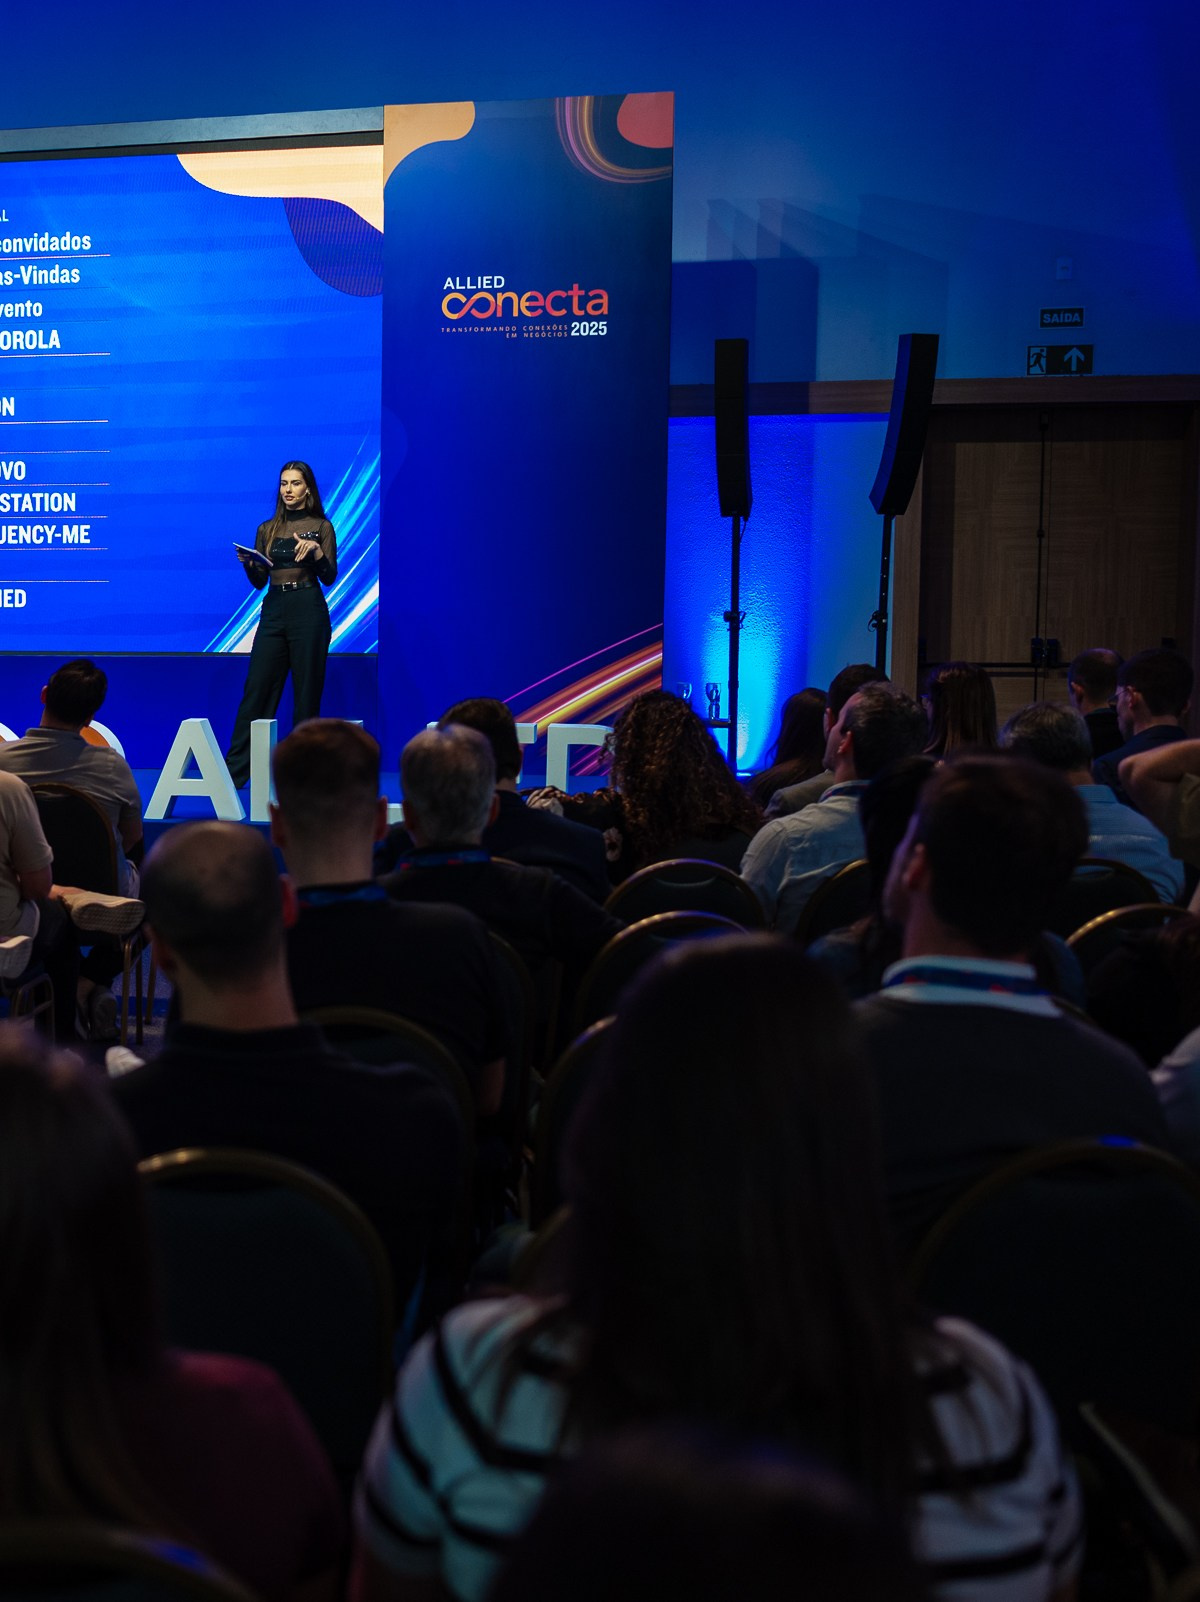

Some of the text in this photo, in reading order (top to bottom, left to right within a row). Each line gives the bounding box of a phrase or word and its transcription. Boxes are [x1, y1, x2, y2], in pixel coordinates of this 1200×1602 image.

[443, 276, 505, 290] ALLIED
[1042, 310, 1081, 324] SAÍDA
[441, 325, 517, 333] TRANSFORMANDO
[571, 321, 608, 336] 2025
